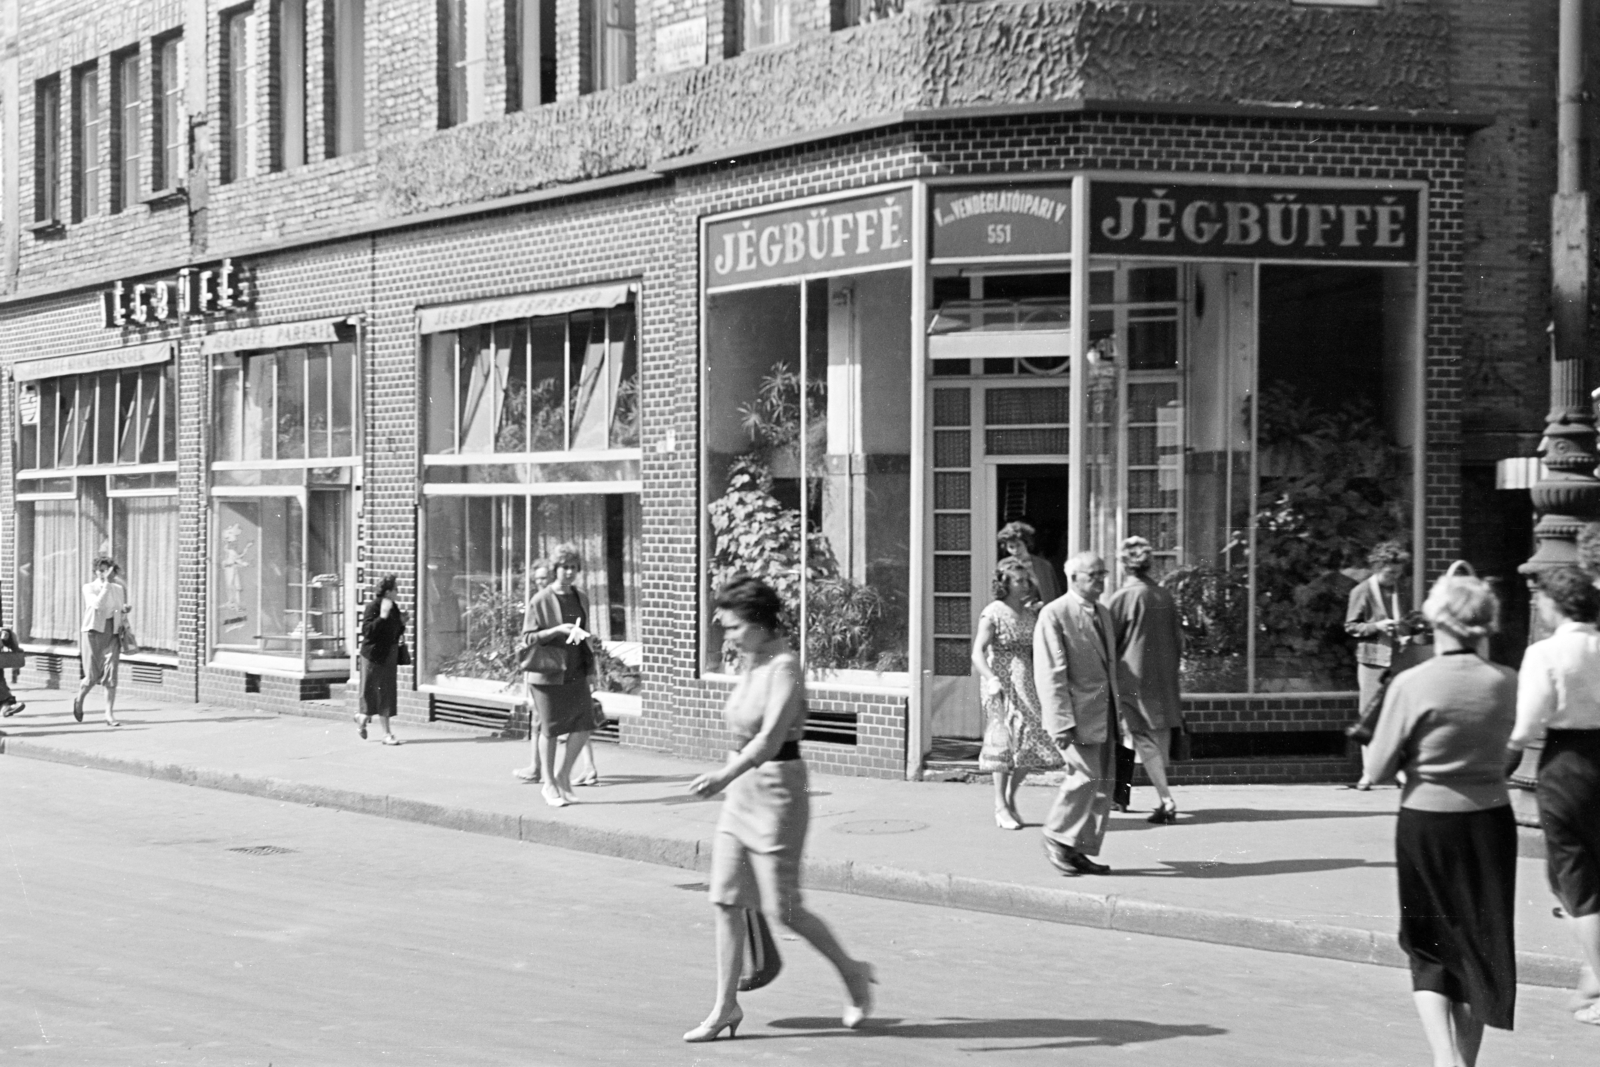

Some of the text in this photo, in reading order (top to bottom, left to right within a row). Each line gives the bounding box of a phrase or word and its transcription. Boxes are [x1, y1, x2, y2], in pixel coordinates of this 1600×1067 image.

[714, 197, 903, 275] JÉGBÜFFÉ
[987, 224, 1011, 244] 551
[1101, 189, 1405, 247] JÉGBÜFFÉ
